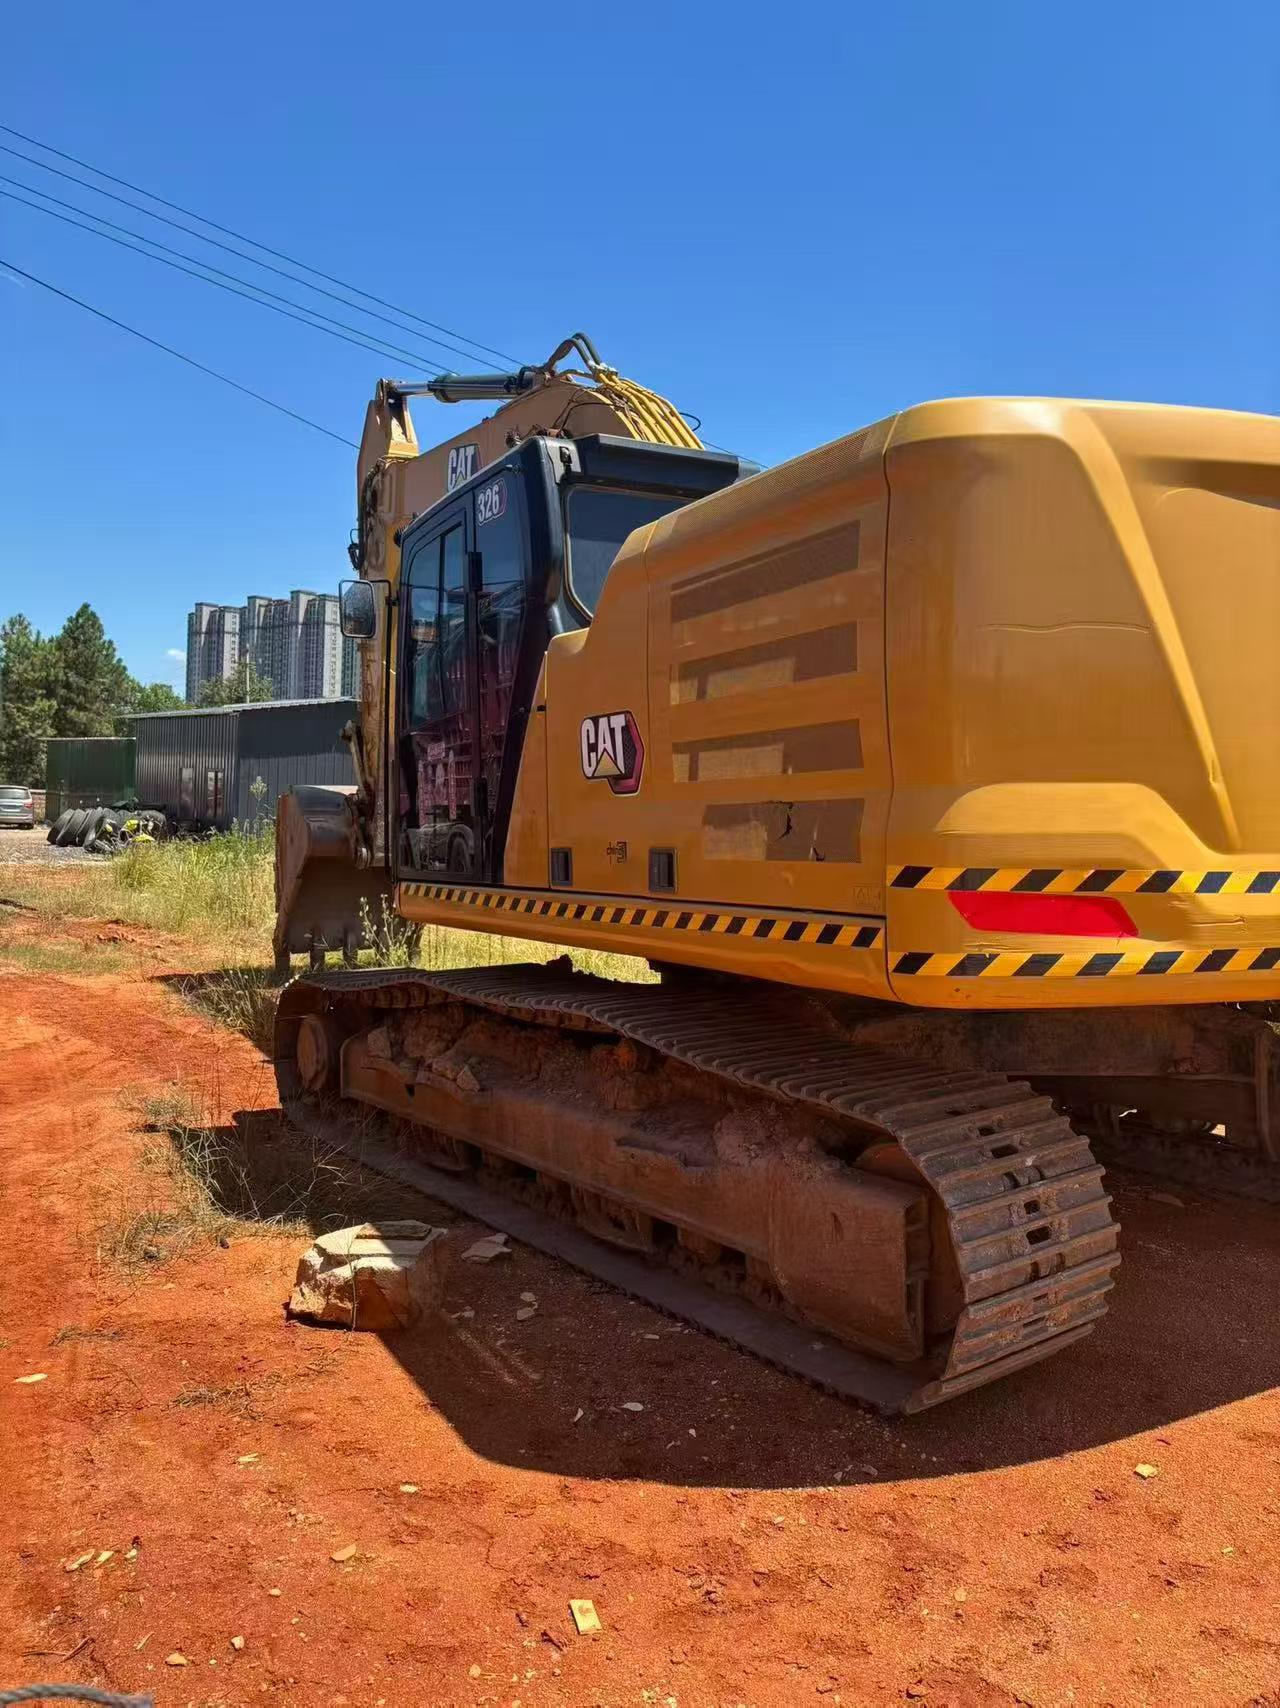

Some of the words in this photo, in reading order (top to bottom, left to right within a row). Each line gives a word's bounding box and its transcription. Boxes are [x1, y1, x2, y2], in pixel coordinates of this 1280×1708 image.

[448, 445, 475, 491] CAT
[477, 484, 500, 523] 326
[581, 714, 626, 778] CAT
